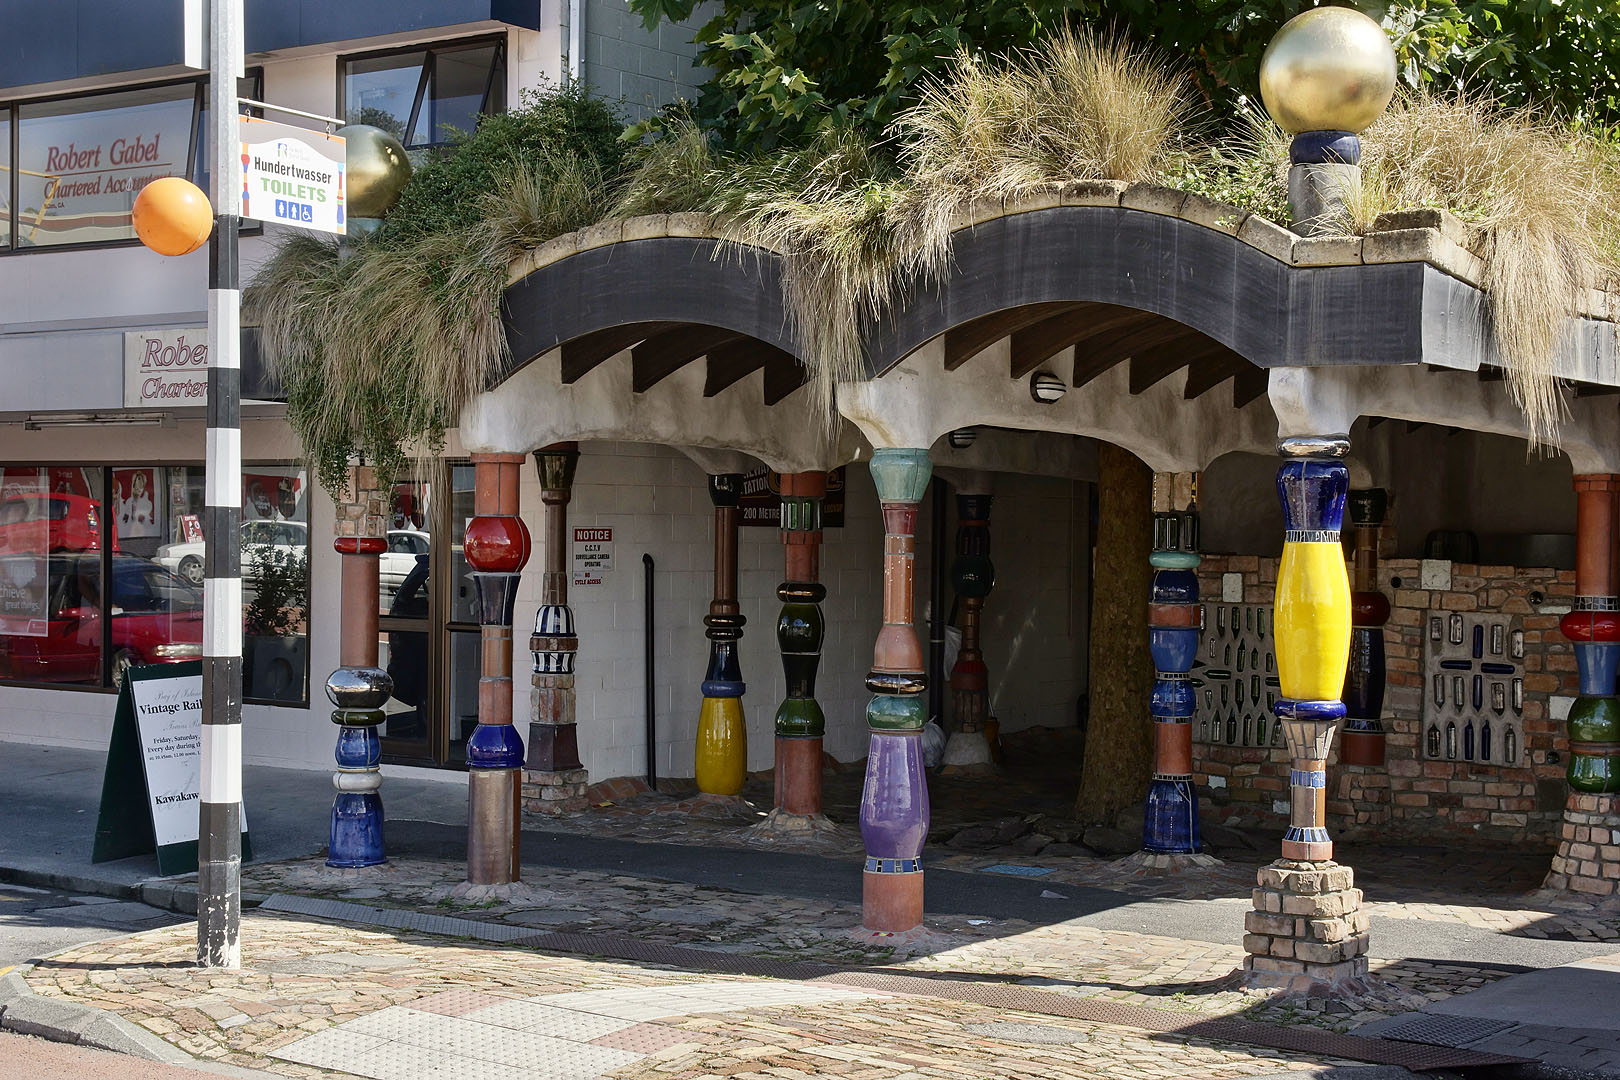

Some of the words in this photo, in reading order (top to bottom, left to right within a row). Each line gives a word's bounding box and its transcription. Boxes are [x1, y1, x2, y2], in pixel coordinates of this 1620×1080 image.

[45, 142, 102, 172] Robert
[109, 132, 161, 165] Gabel
[254, 157, 332, 184] Hundertwasser
[43, 176, 101, 200] Chartered
[260, 177, 327, 203] TOILETS
[743, 507, 757, 519] 200
[577, 530, 609, 540] NOTICE
[140, 703, 181, 716] Vintage
[182, 698, 203, 711] Rail
[164, 744, 176, 752] day
[176, 741, 196, 750] during
[155, 791, 200, 805] Kawakaw
